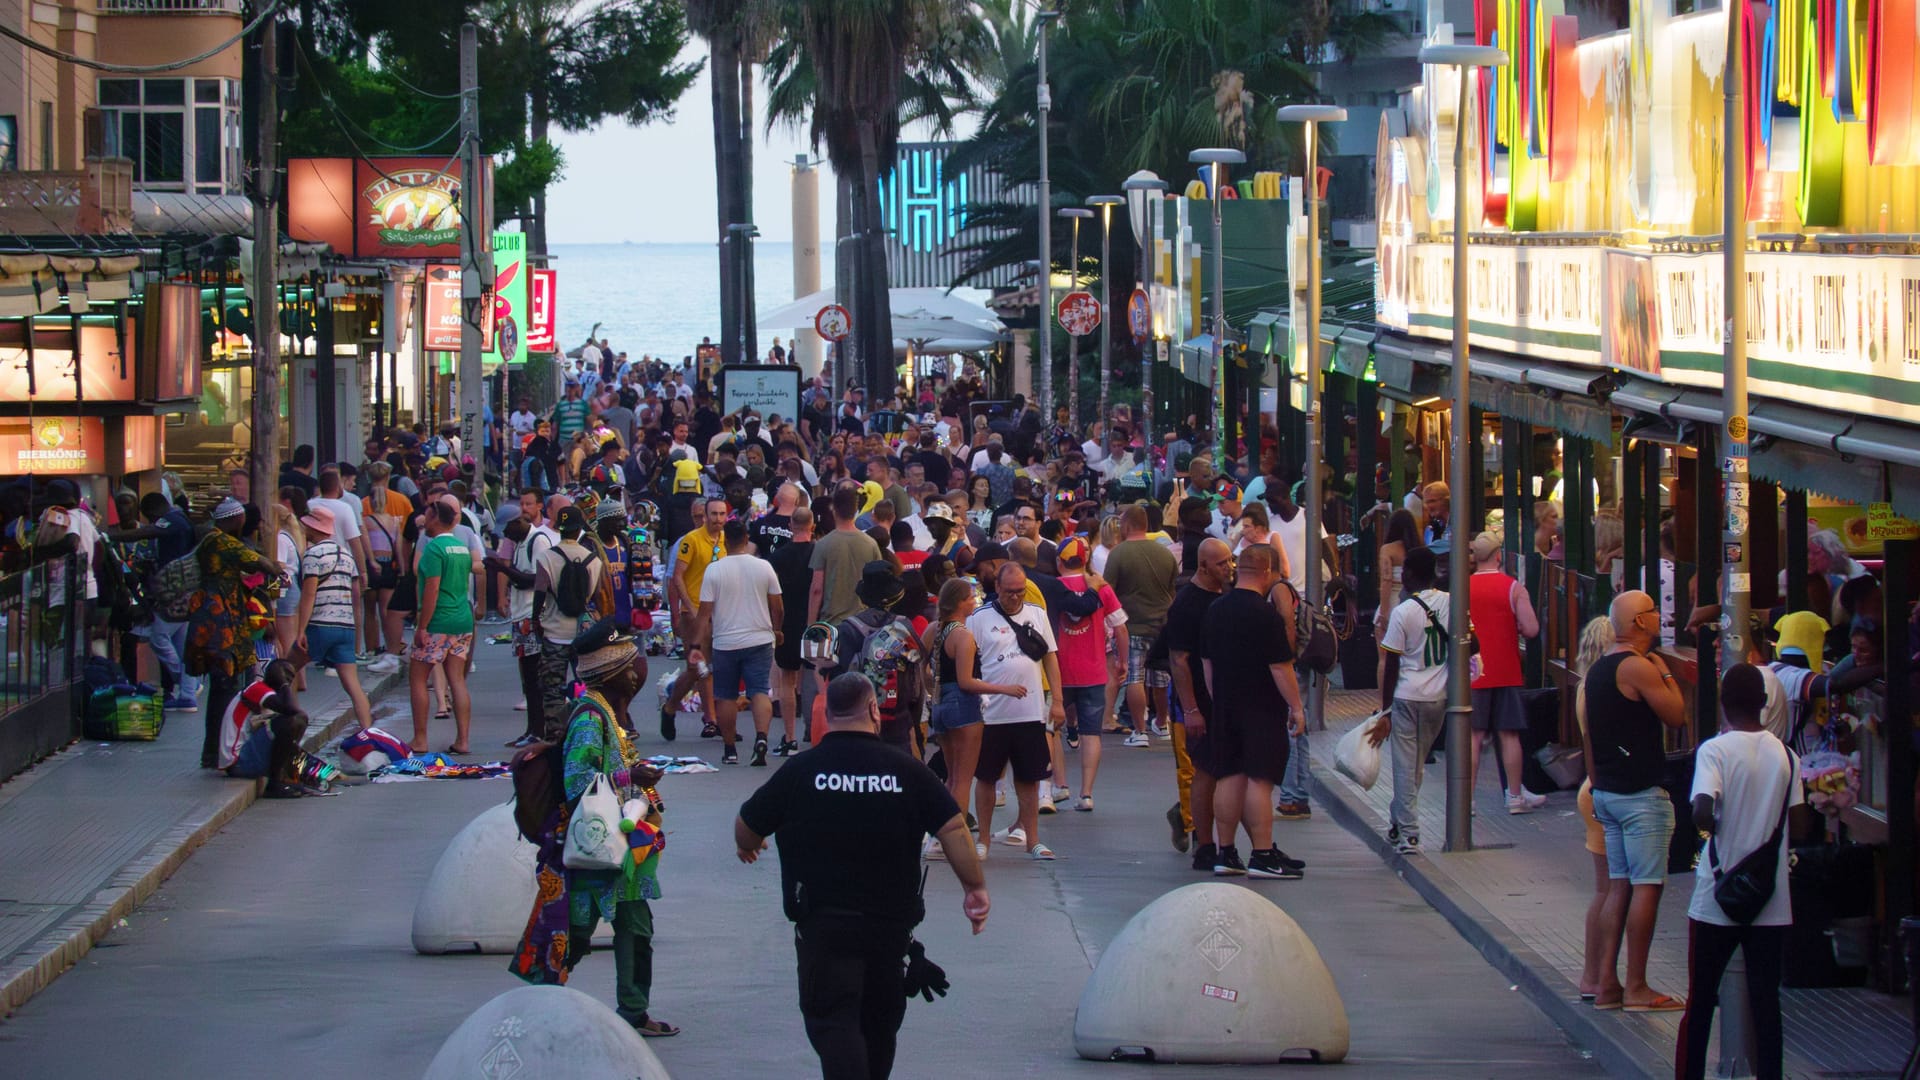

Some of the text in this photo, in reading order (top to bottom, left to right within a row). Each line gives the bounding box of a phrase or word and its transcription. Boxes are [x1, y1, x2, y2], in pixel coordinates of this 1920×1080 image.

[17, 448, 87, 460] BIERKÖNIG
[18, 459, 87, 471] FAN SHOP
[680, 543, 690, 555] 3
[815, 773, 903, 793] CONTROL
